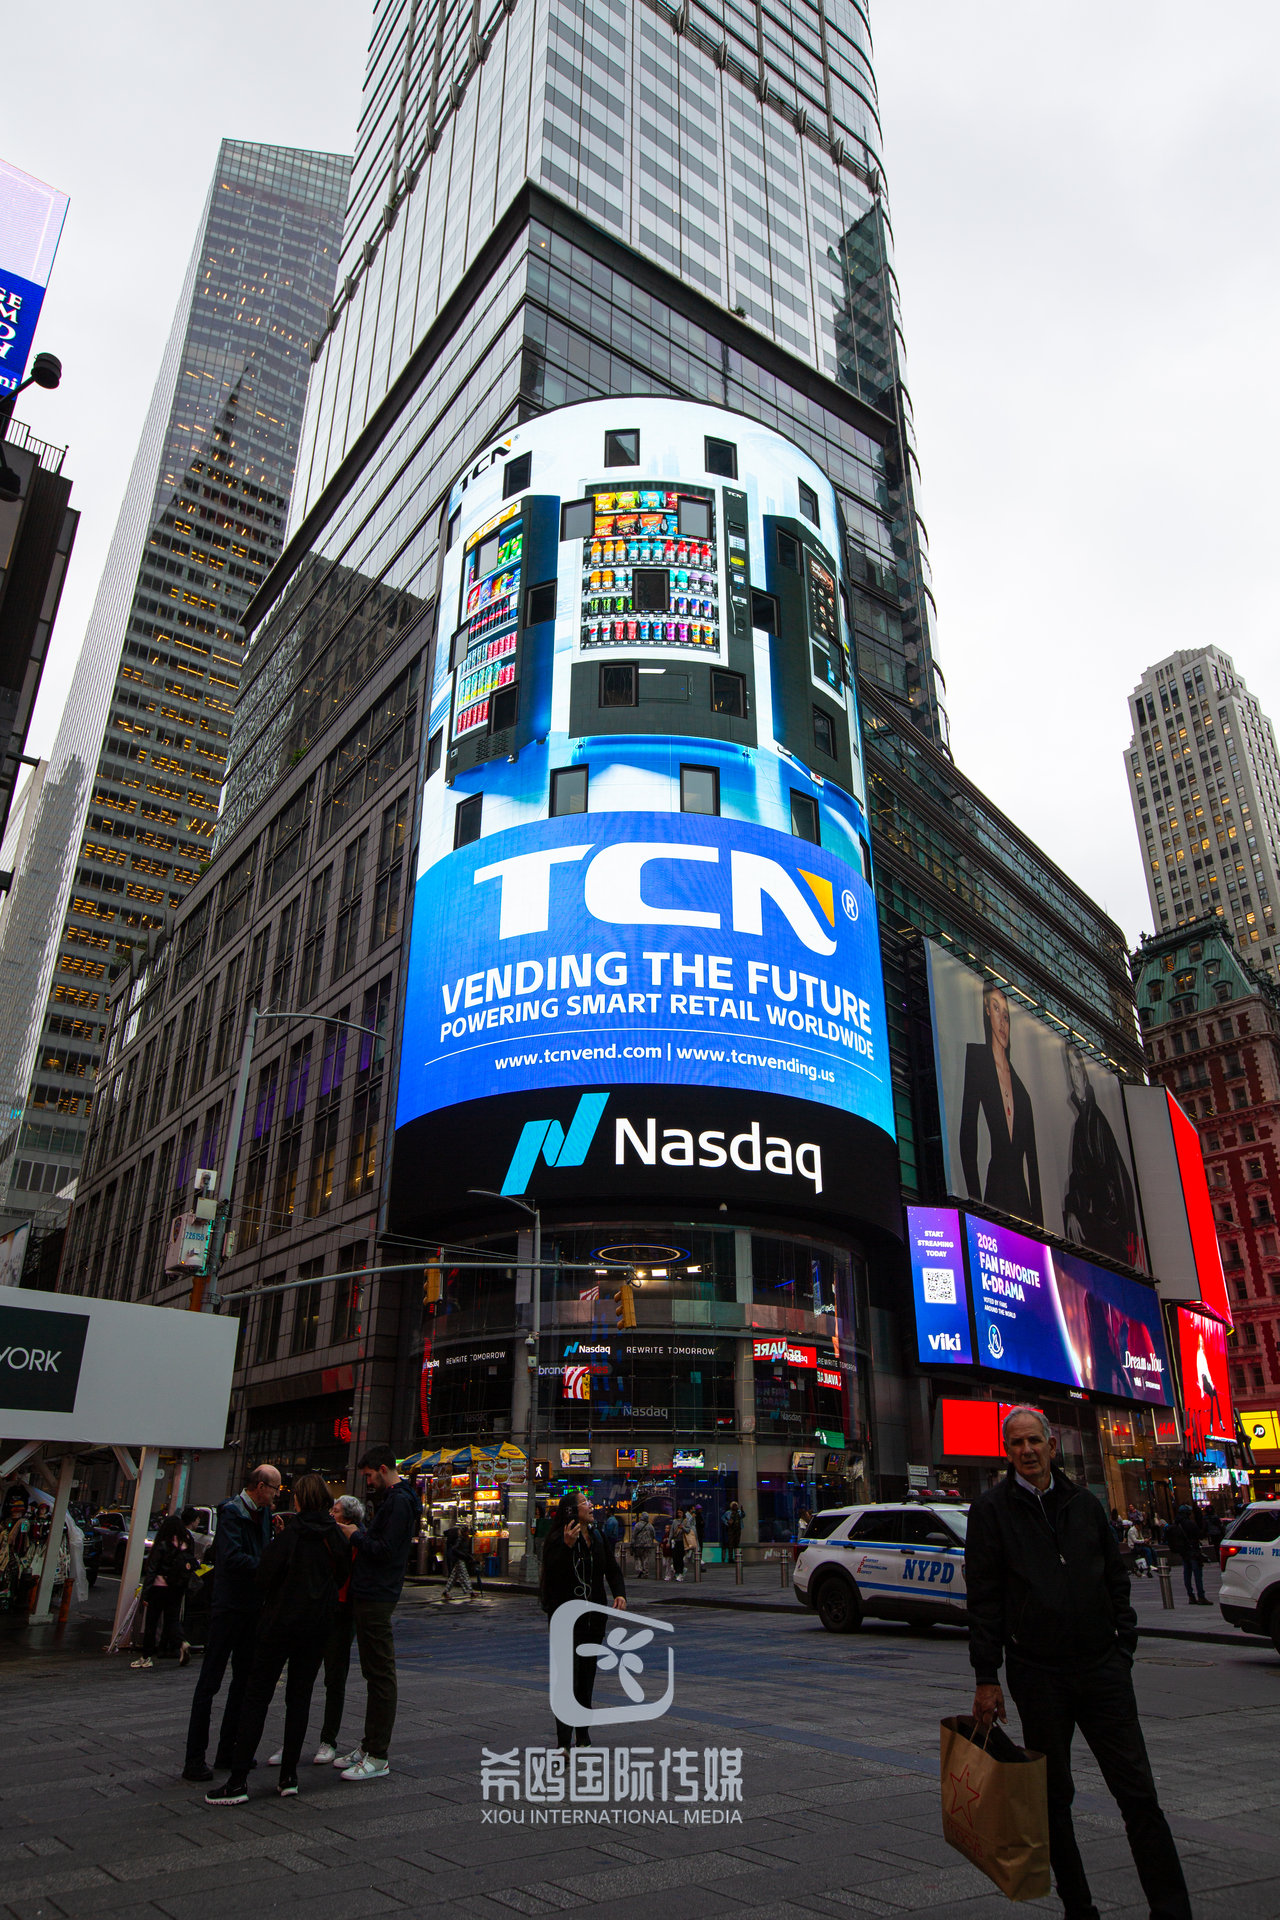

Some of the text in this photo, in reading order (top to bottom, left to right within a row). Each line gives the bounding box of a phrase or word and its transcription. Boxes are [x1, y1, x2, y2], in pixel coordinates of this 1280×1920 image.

[473, 841, 838, 957] TCN
[441, 950, 873, 1036] VENDING THE FUTURE
[439, 993, 875, 1061] POWERING SMART RETAIL WORLDWIDE
[494, 1043, 836, 1084] www.tcnvend.com www.tcnvending.us
[614, 1117, 824, 1195] Nasdaq
[917, 1239, 954, 1248] STREAMING
[924, 1230, 944, 1238] START
[976, 1232, 998, 1253] 2026
[925, 1249, 947, 1257] TODAY
[979, 1251, 1041, 1288] FAN FAVORITE
[981, 1272, 1026, 1302] K-DRAMA
[578, 1344, 716, 1356] Nasdaq REWRITE TOMORROW
[927, 1332, 962, 1351] Viki
[1122, 1350, 1147, 1370] Dream
[1150, 1352, 1165, 1373] You
[622, 1405, 669, 1420] Nasdaq
[902, 1558, 955, 1584] NYPD
